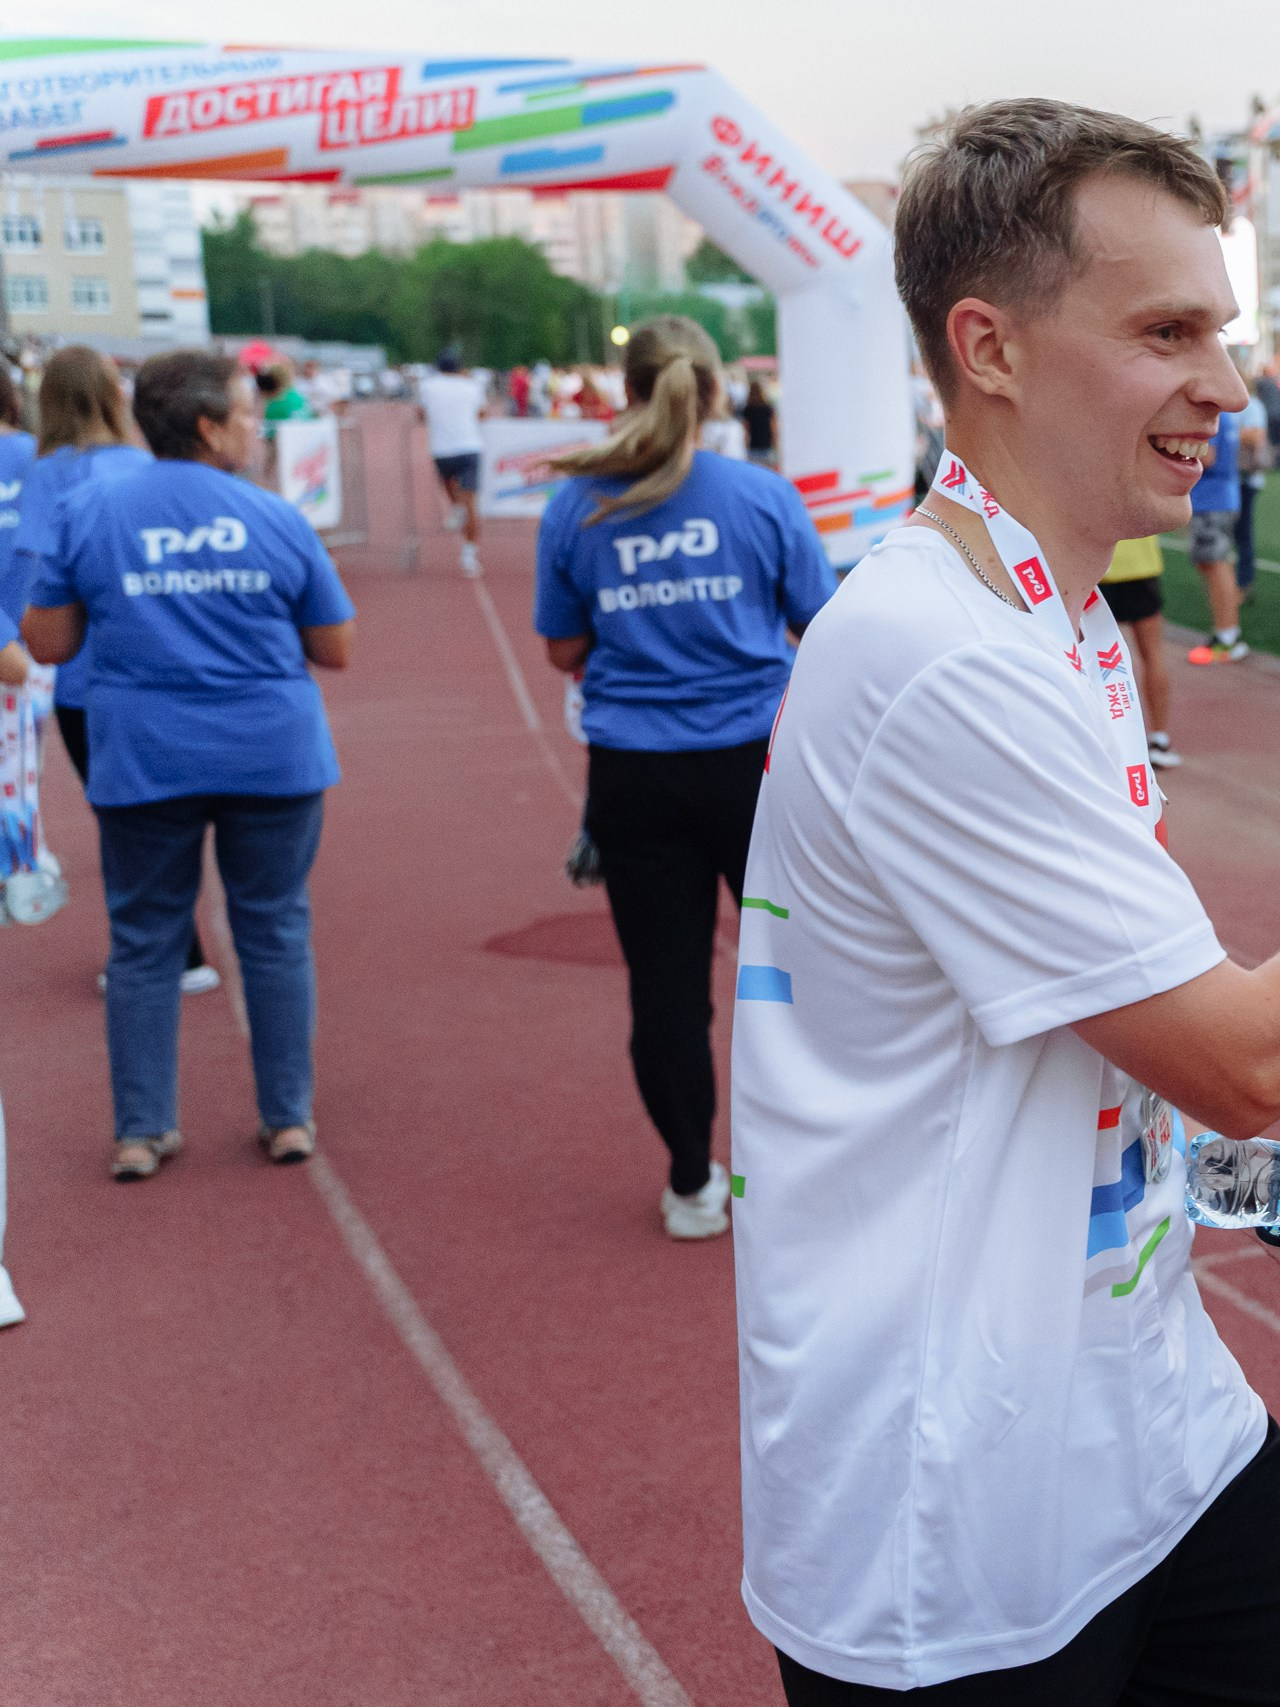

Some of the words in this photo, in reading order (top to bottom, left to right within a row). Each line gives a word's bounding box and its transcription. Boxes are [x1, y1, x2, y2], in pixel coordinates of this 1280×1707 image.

[156, 73, 387, 134] ДОСТИГАЯ
[326, 89, 473, 145] ЦЕЛИ!
[710, 115, 862, 260] ФИНИШ
[123, 569, 271, 597] ВОЛОНТЕР
[599, 575, 743, 613] ВОЛОНТЕР
[1105, 683, 1124, 720] РЖД
[1118, 681, 1126, 692] 20
[1122, 693, 1131, 710] ЛЕТ
